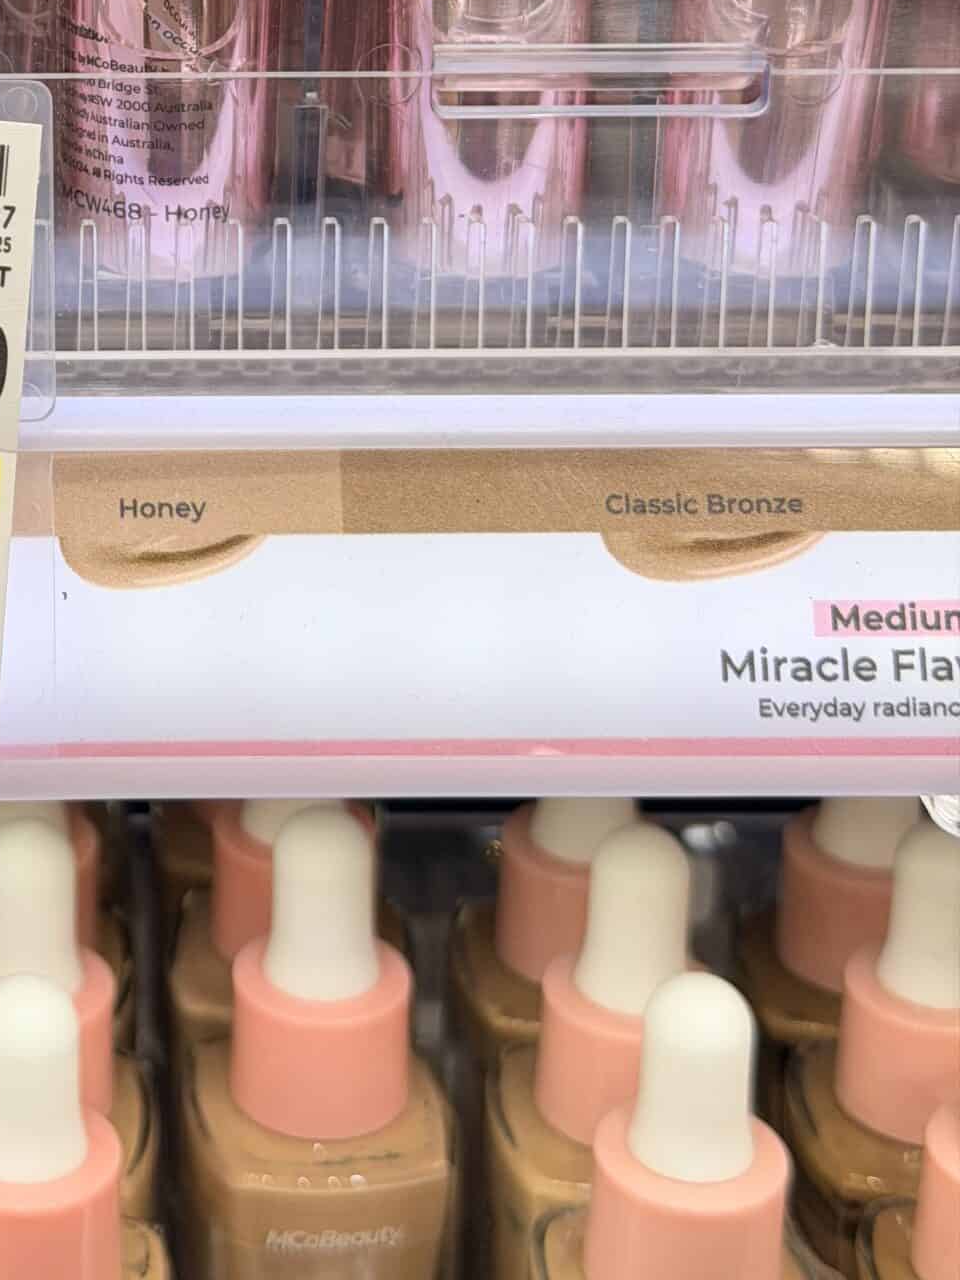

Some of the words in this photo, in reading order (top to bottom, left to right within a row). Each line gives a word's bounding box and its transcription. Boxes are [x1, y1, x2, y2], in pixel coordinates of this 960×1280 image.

[99, 78, 141, 94] Bridge
[154, 100, 213, 114] Australia
[154, 120, 205, 130] Owned
[104, 168, 145, 187] Rights
[148, 174, 209, 187] Reserved
[165, 203, 230, 223] Honey
[119, 496, 207, 524] Honey
[605, 491, 698, 516] Classic
[706, 493, 804, 515] Bronze
[720, 646, 878, 683] Miracle
[892, 646, 960, 682] Fla
[758, 698, 867, 722] Everyday
